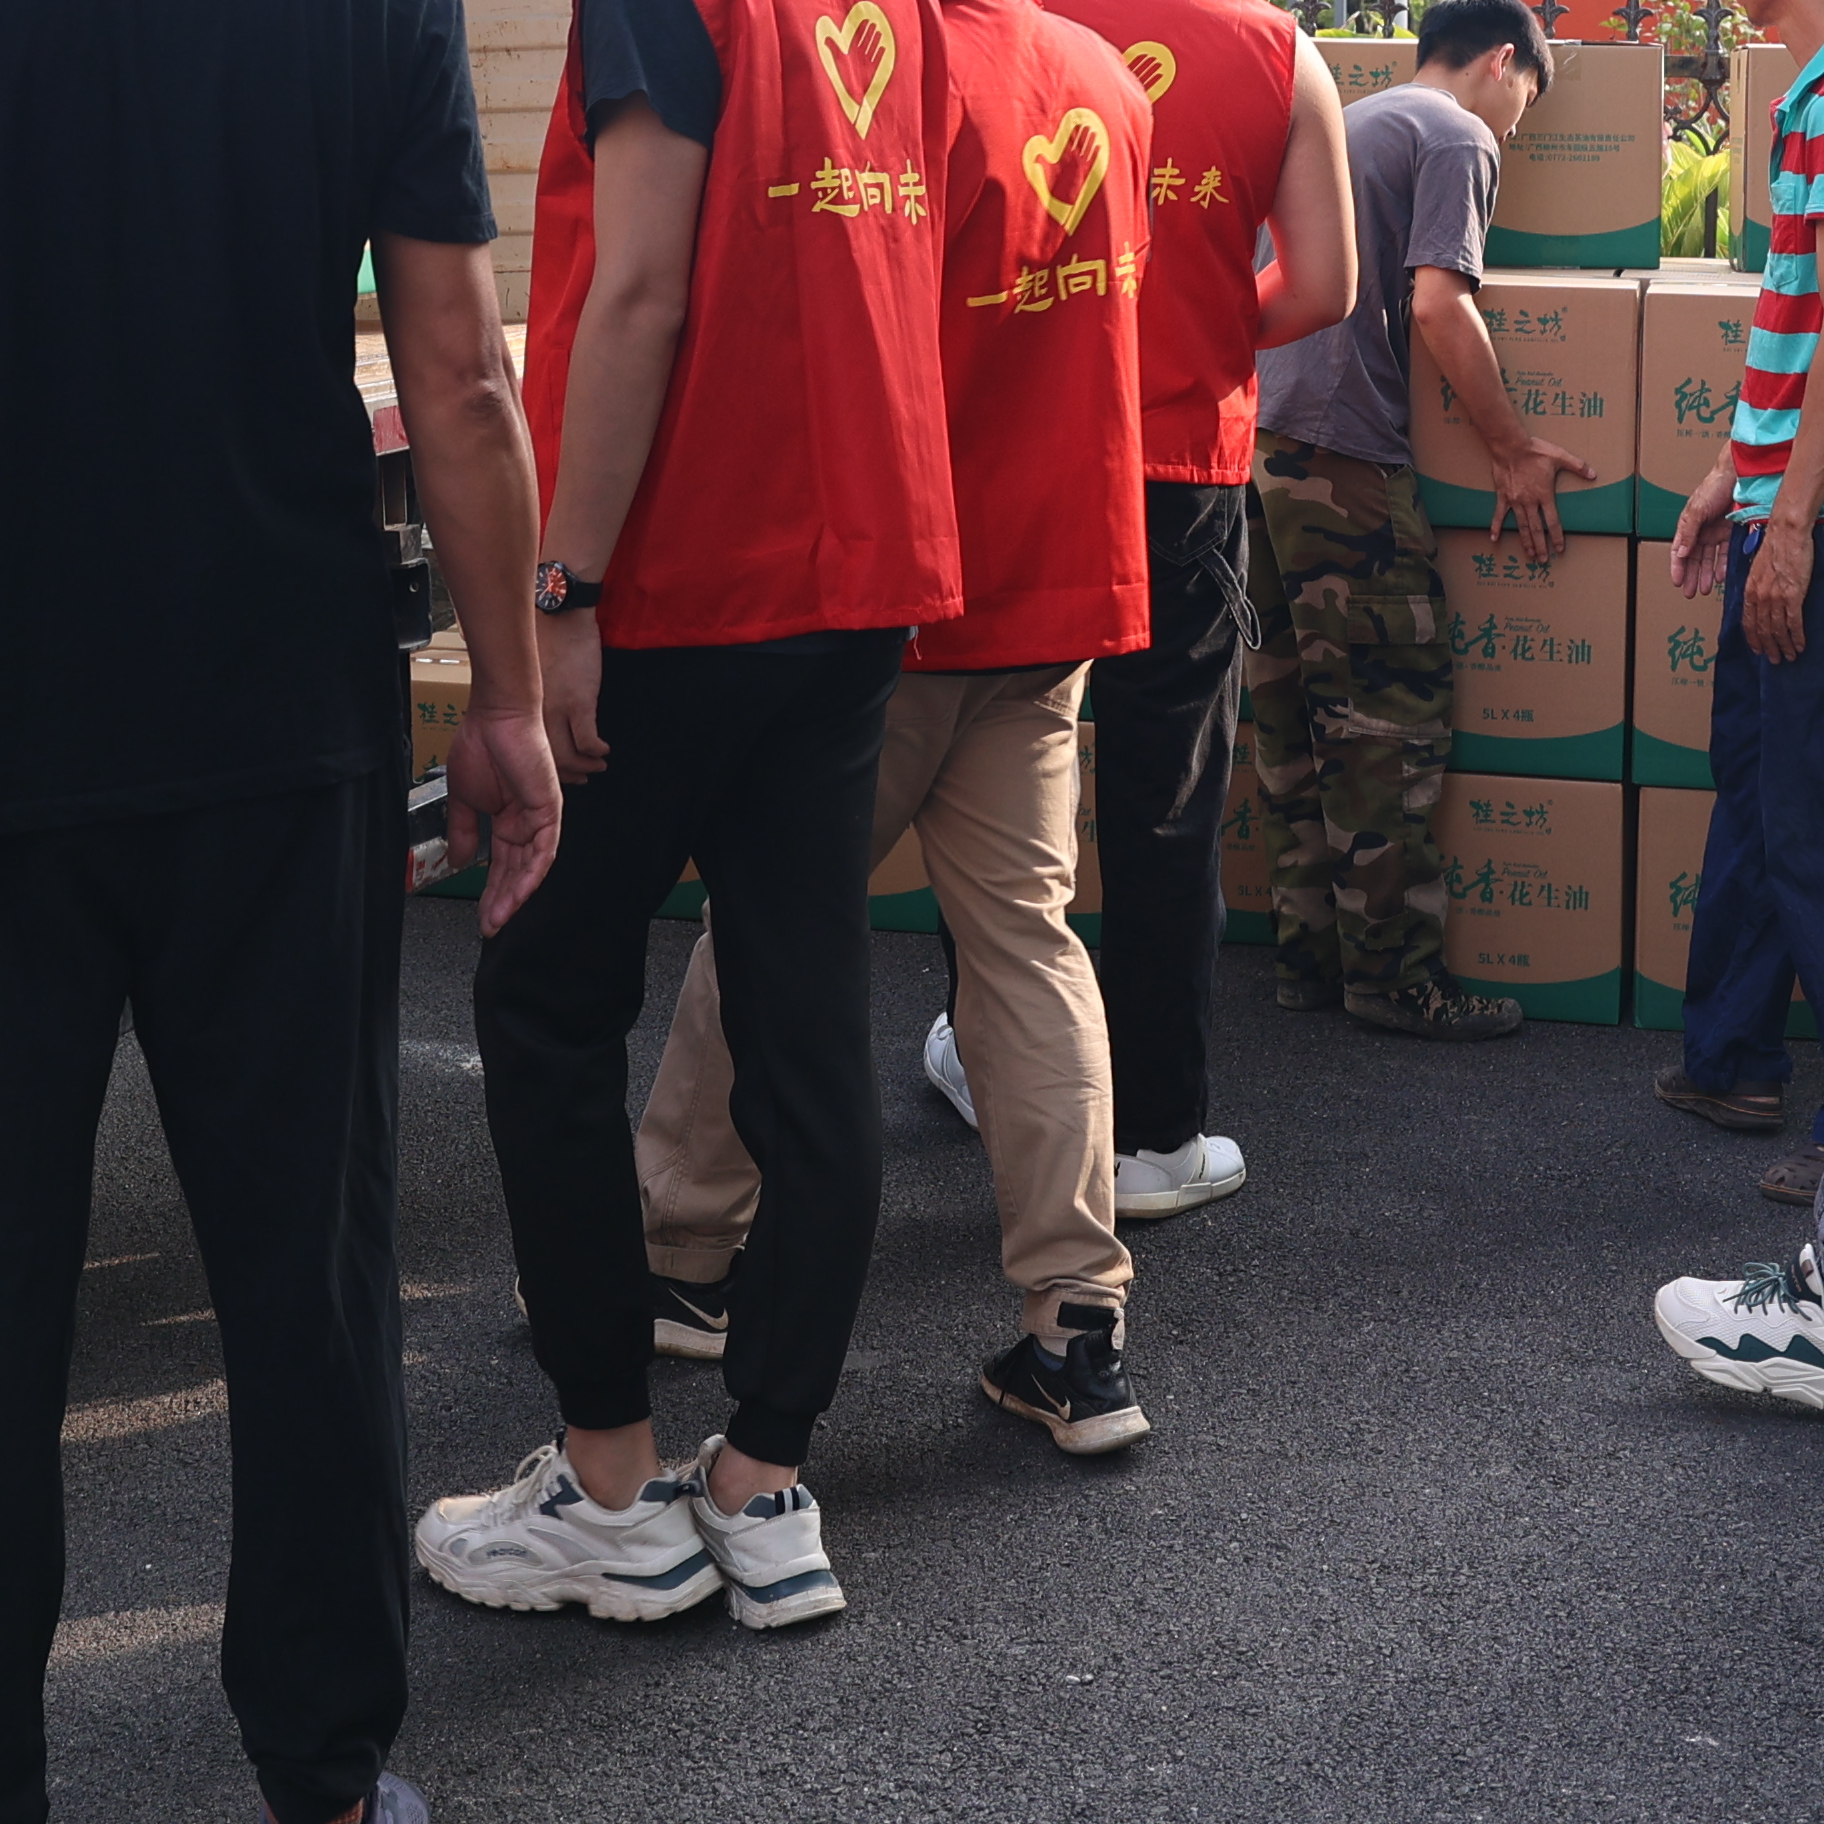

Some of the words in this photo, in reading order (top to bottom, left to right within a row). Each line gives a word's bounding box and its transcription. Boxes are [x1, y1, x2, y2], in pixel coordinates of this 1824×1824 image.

[1482, 308, 1563, 336] 桂之坊
[1469, 799, 1549, 829] 桂之坊
